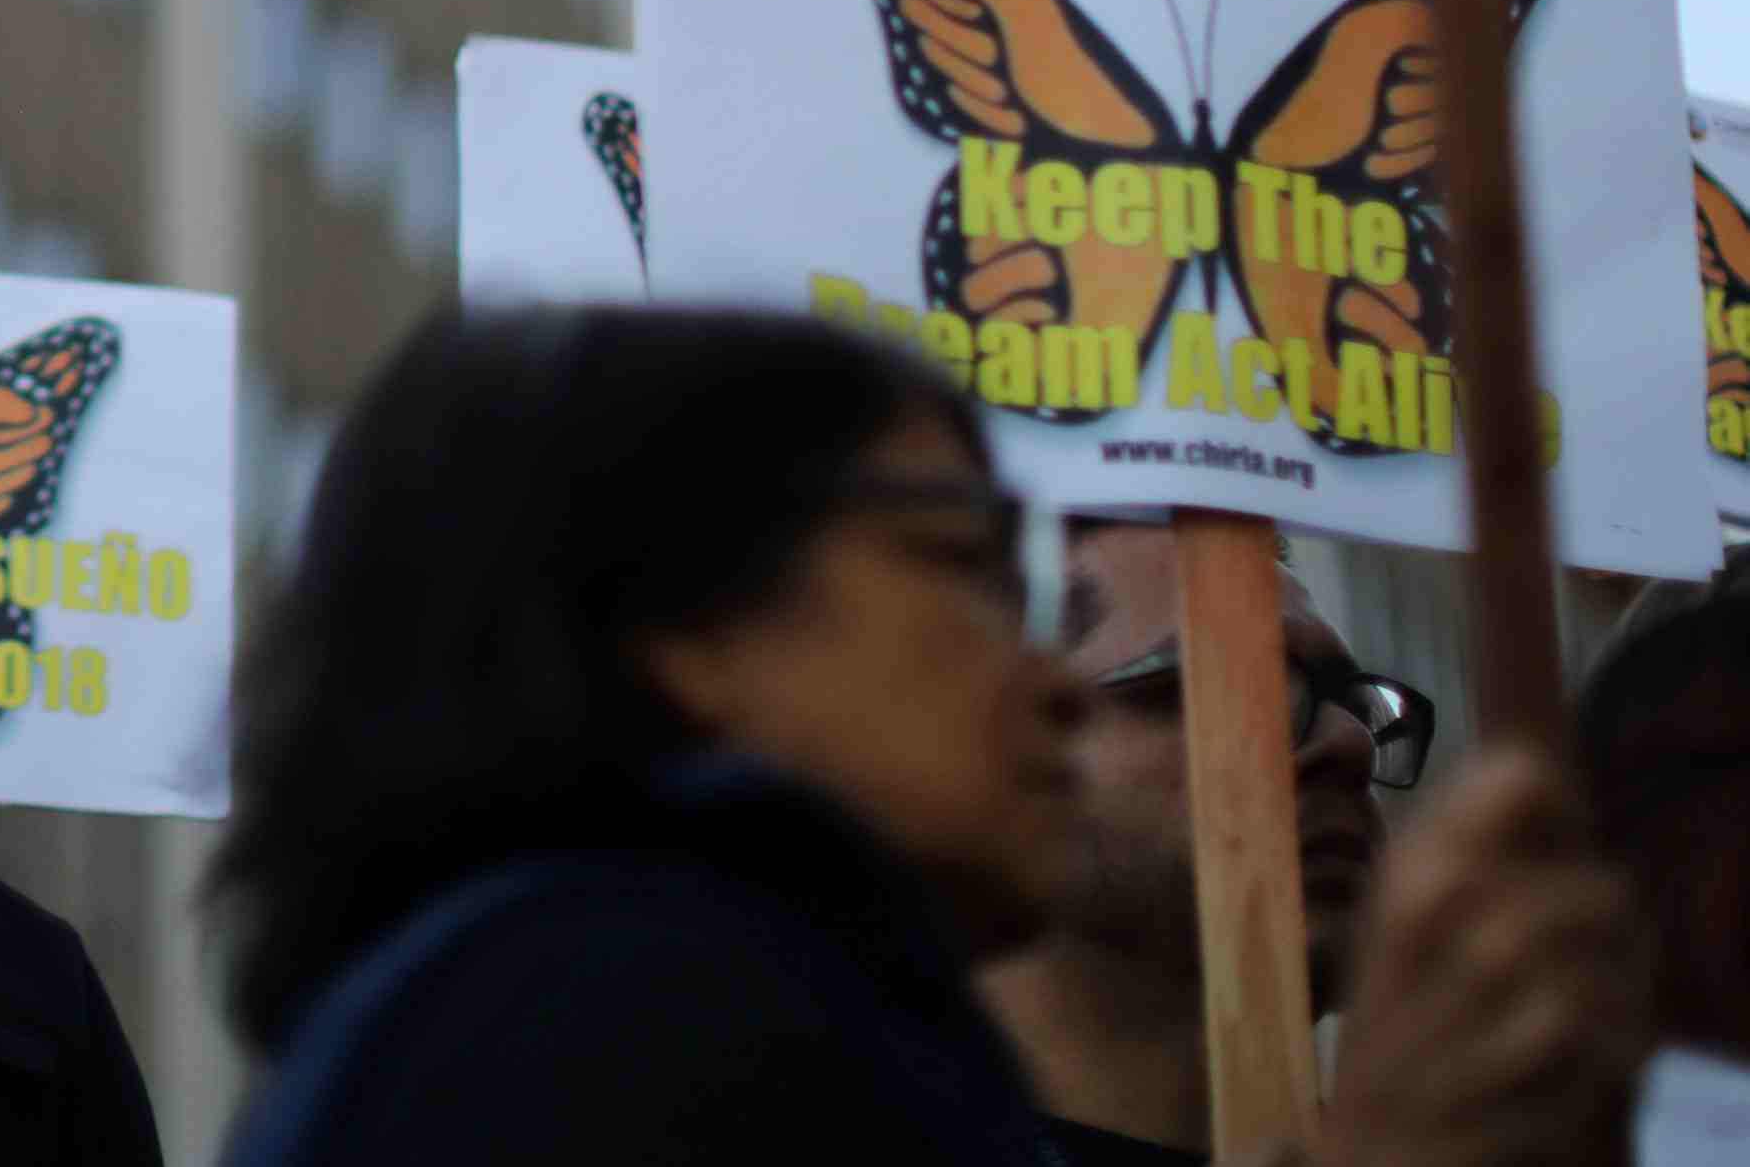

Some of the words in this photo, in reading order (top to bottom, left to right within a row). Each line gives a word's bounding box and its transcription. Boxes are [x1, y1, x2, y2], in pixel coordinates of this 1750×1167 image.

[957, 135, 1224, 259] Keep
[1236, 159, 1409, 285] The
[809, 269, 1140, 413] eam
[1164, 309, 1318, 435] Act
[1100, 437, 1316, 490] www.chirla.org
